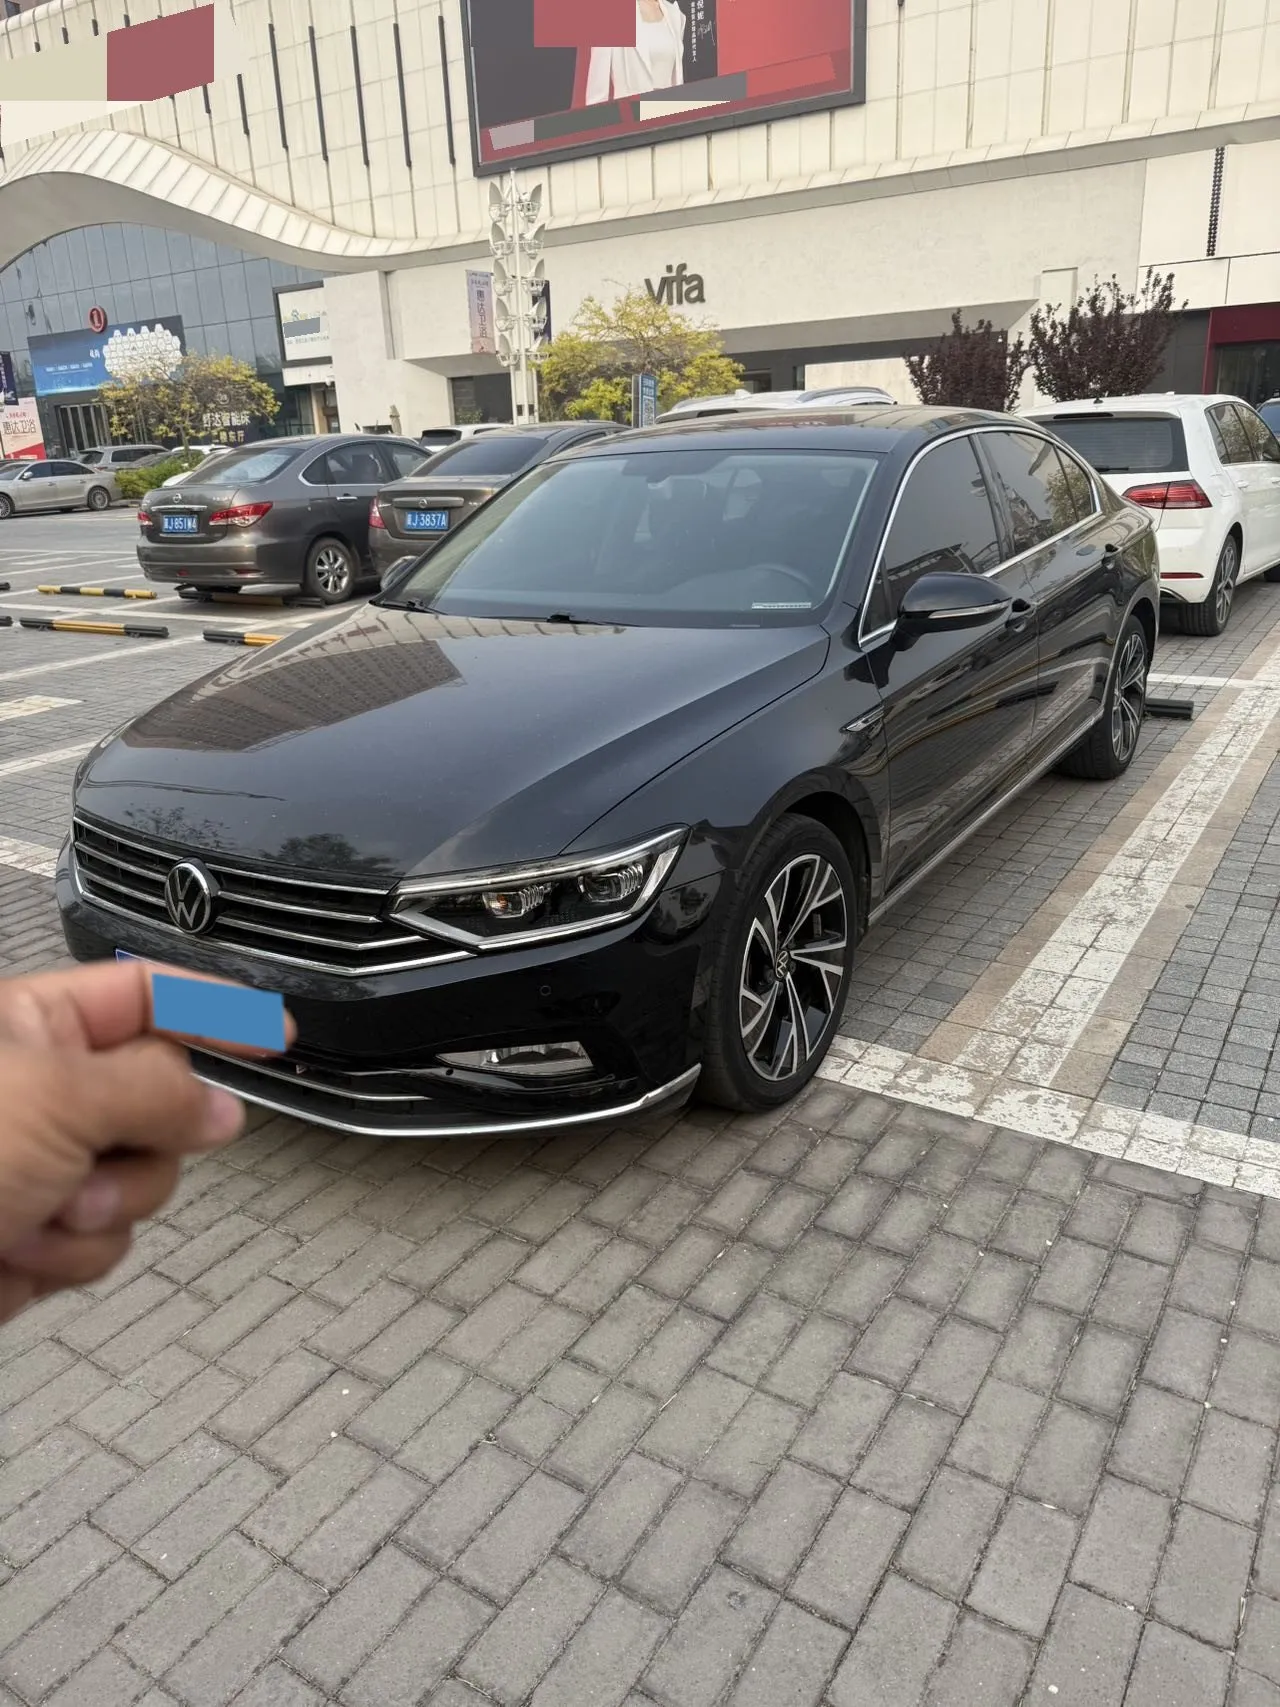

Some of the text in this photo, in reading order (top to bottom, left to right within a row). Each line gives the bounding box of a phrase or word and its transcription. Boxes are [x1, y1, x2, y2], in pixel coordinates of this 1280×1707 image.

[644, 262, 706, 306] vifa
[2, 419, 37, 435] 惠达卫浴
